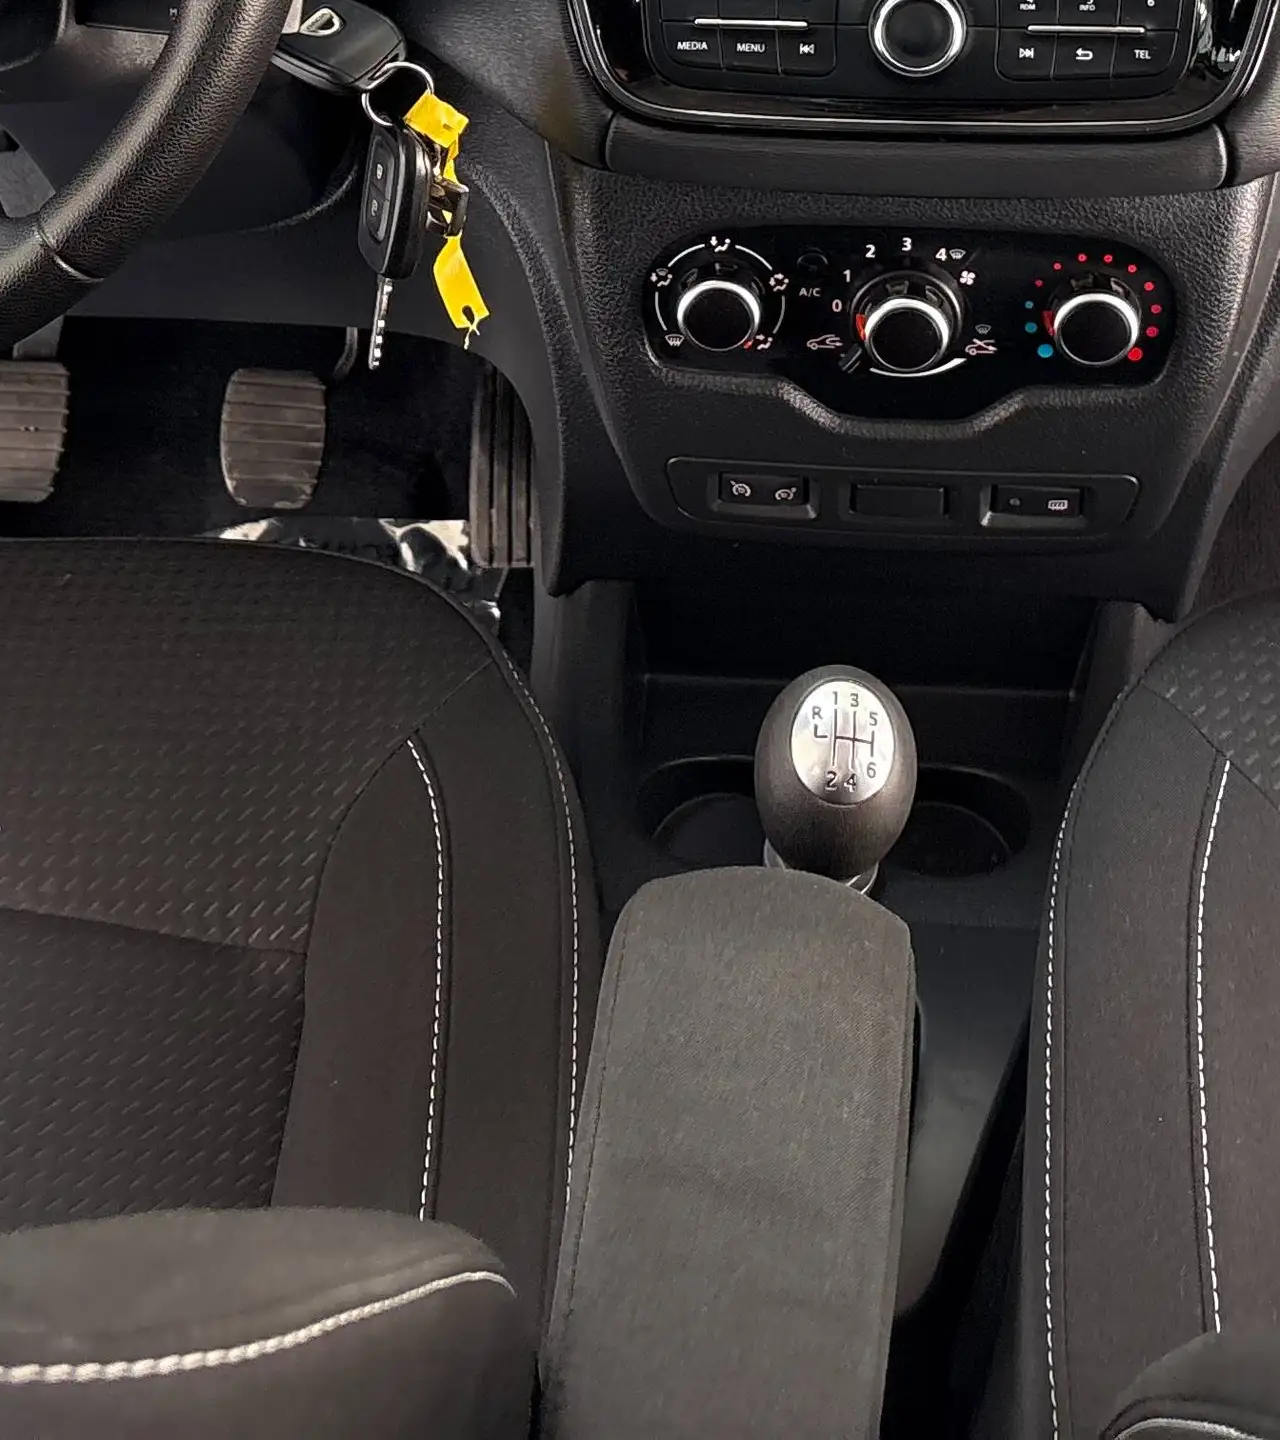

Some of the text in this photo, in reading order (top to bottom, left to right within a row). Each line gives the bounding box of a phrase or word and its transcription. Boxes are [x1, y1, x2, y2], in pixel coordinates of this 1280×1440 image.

[677, 41, 709, 51] MEDIA
[736, 42, 766, 53] MENU
[1133, 49, 1151, 60] TEL
[865, 244, 876, 258] 2
[901, 237, 912, 251] 3
[935, 248, 947, 261] 4
[843, 269, 851, 283] 1
[798, 287, 822, 297] A/C
[831, 299, 843, 312] 0
[832, 690, 838, 706] 1
[849, 692, 859, 708] 3
[811, 706, 824, 720] R
[868, 711, 878, 726] 5
[866, 762, 877, 779] 6
[824, 771, 838, 791] 2
[844, 773, 859, 792] 4
